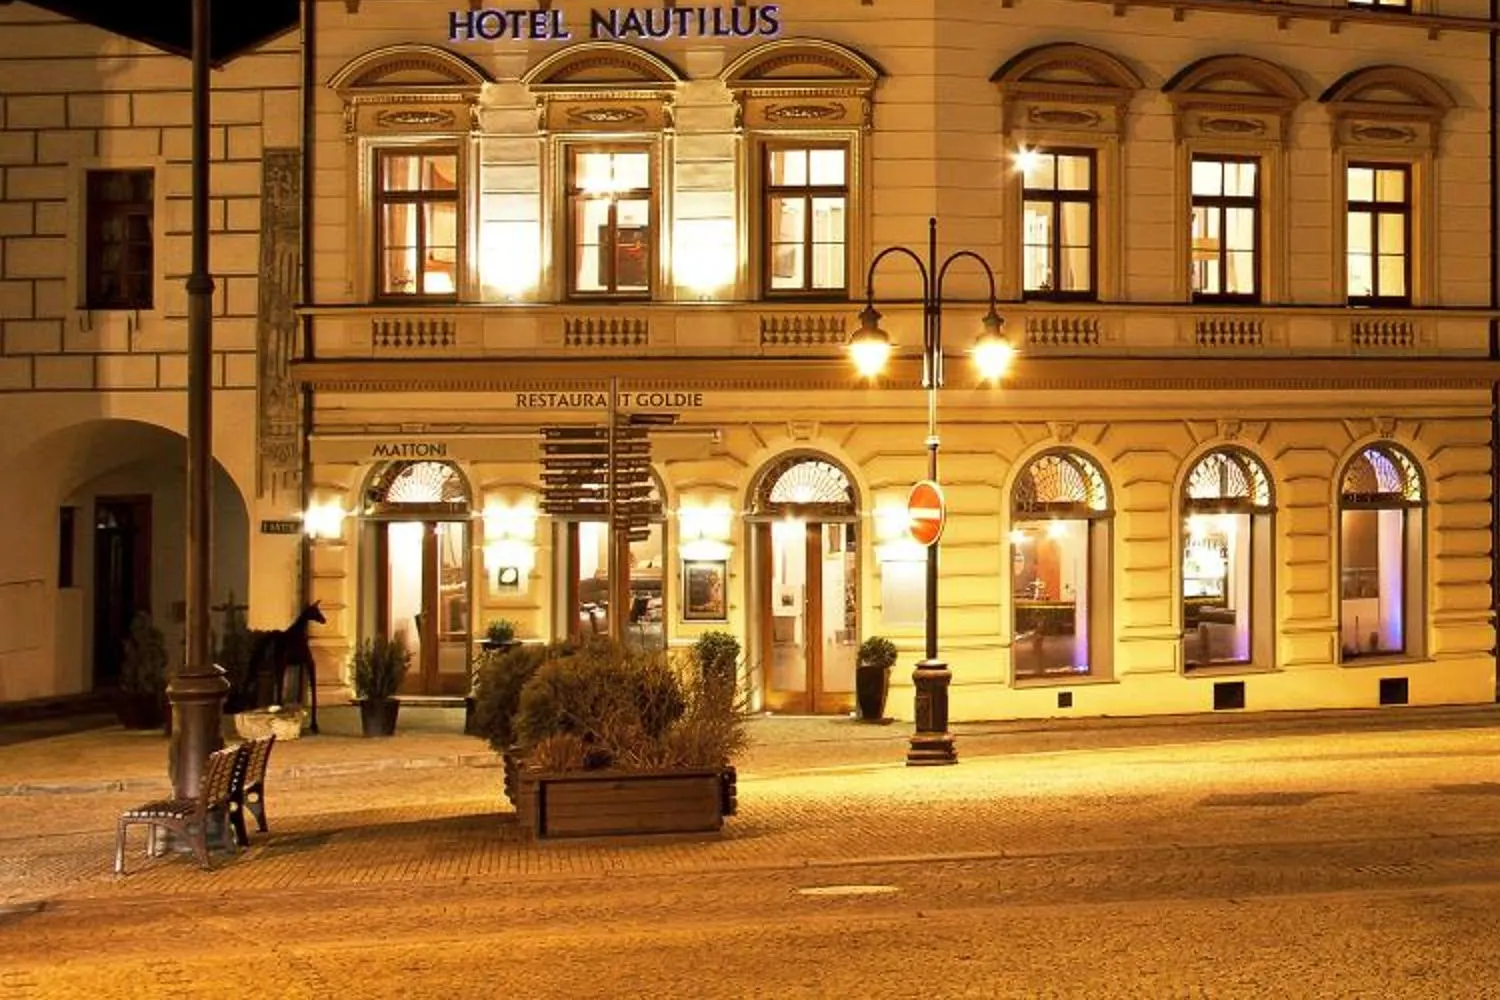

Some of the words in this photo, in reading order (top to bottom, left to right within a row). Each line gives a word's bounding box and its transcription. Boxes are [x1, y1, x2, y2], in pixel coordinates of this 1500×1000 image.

[448, 8, 571, 41] HOTEL
[589, 4, 780, 40] NAUTILUS
[516, 393, 633, 408] RESTAURAT
[637, 393, 703, 407] GOLDIE
[372, 443, 447, 457] MATTONI
